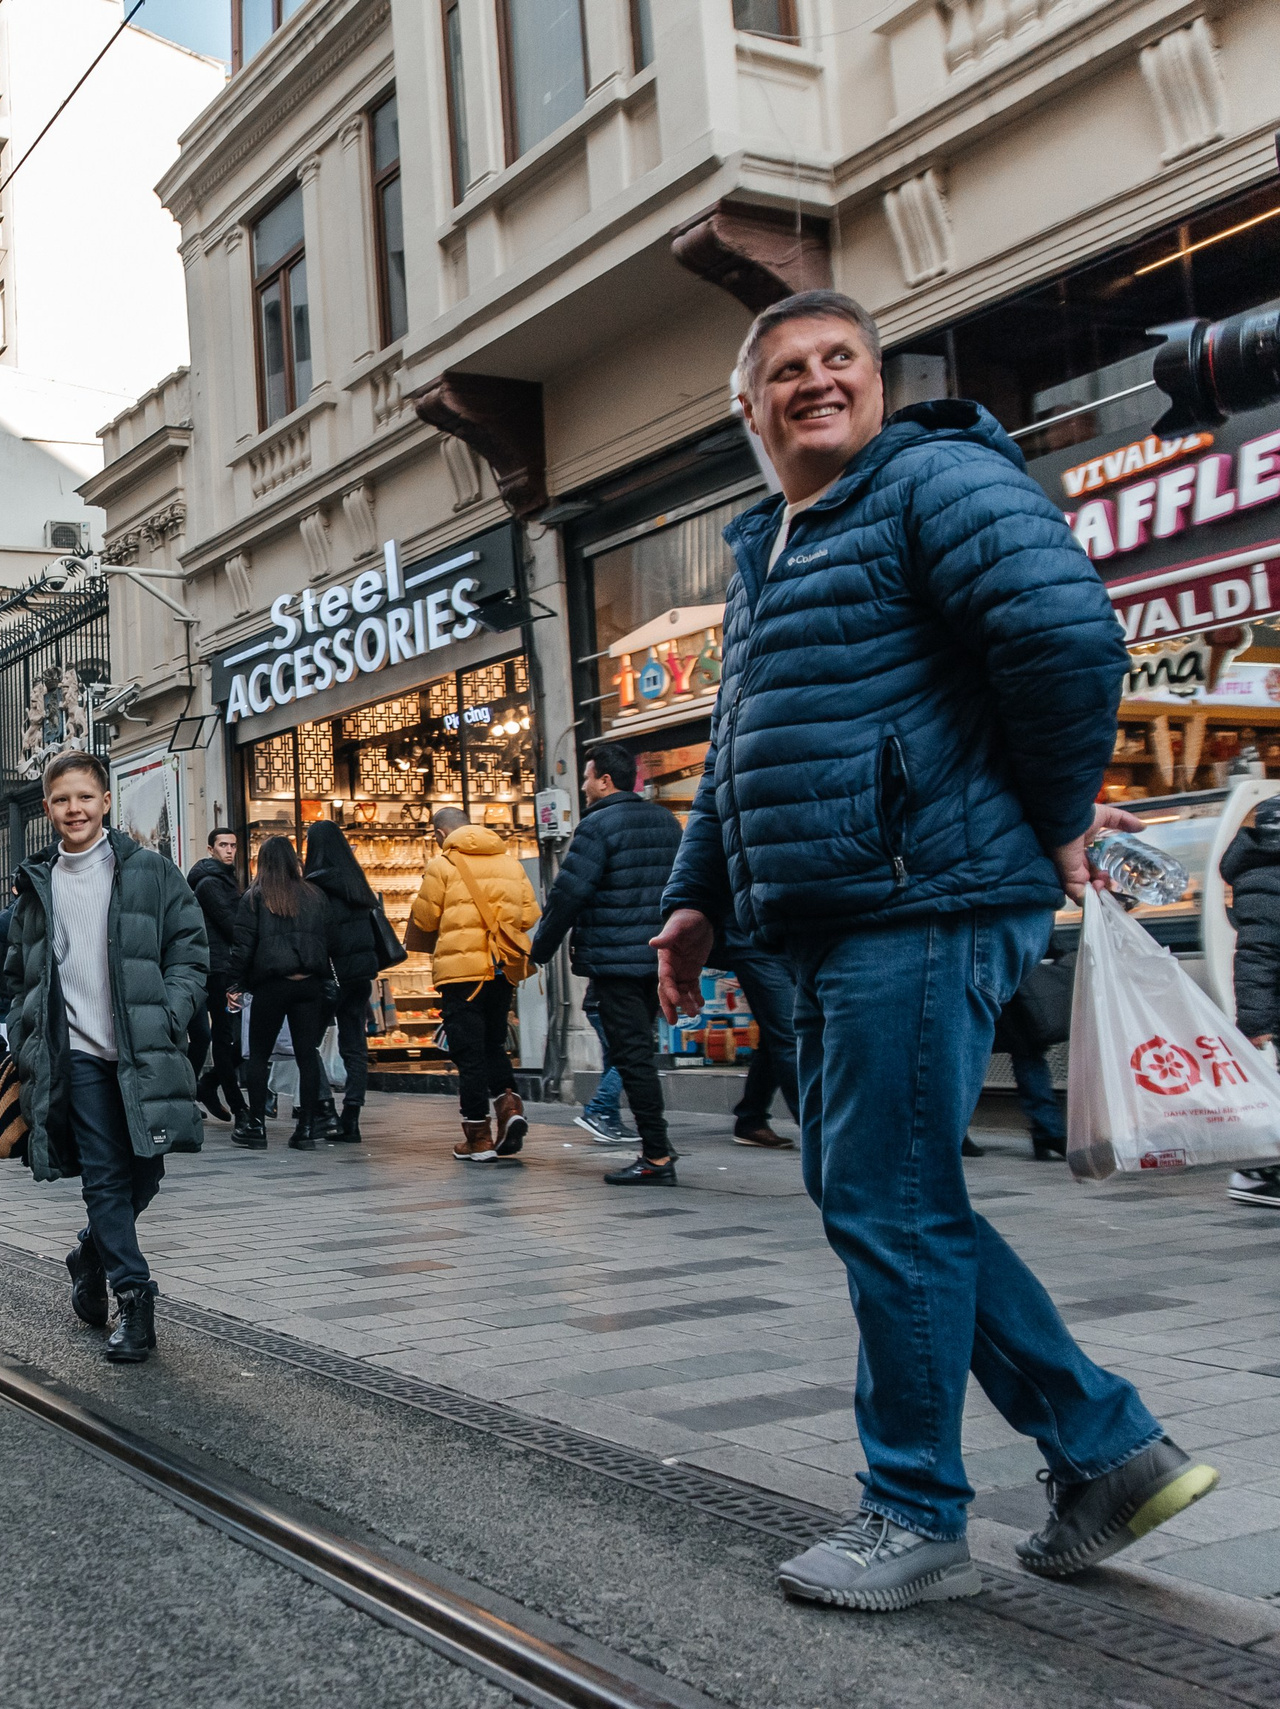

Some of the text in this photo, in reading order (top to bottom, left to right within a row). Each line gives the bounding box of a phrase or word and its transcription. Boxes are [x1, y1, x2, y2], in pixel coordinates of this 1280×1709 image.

[1070, 430, 1280, 559] AFFLE
[225, 577, 482, 725] ACCESSORIES
[270, 538, 405, 650] Steel
[443, 706, 491, 731] Picing
